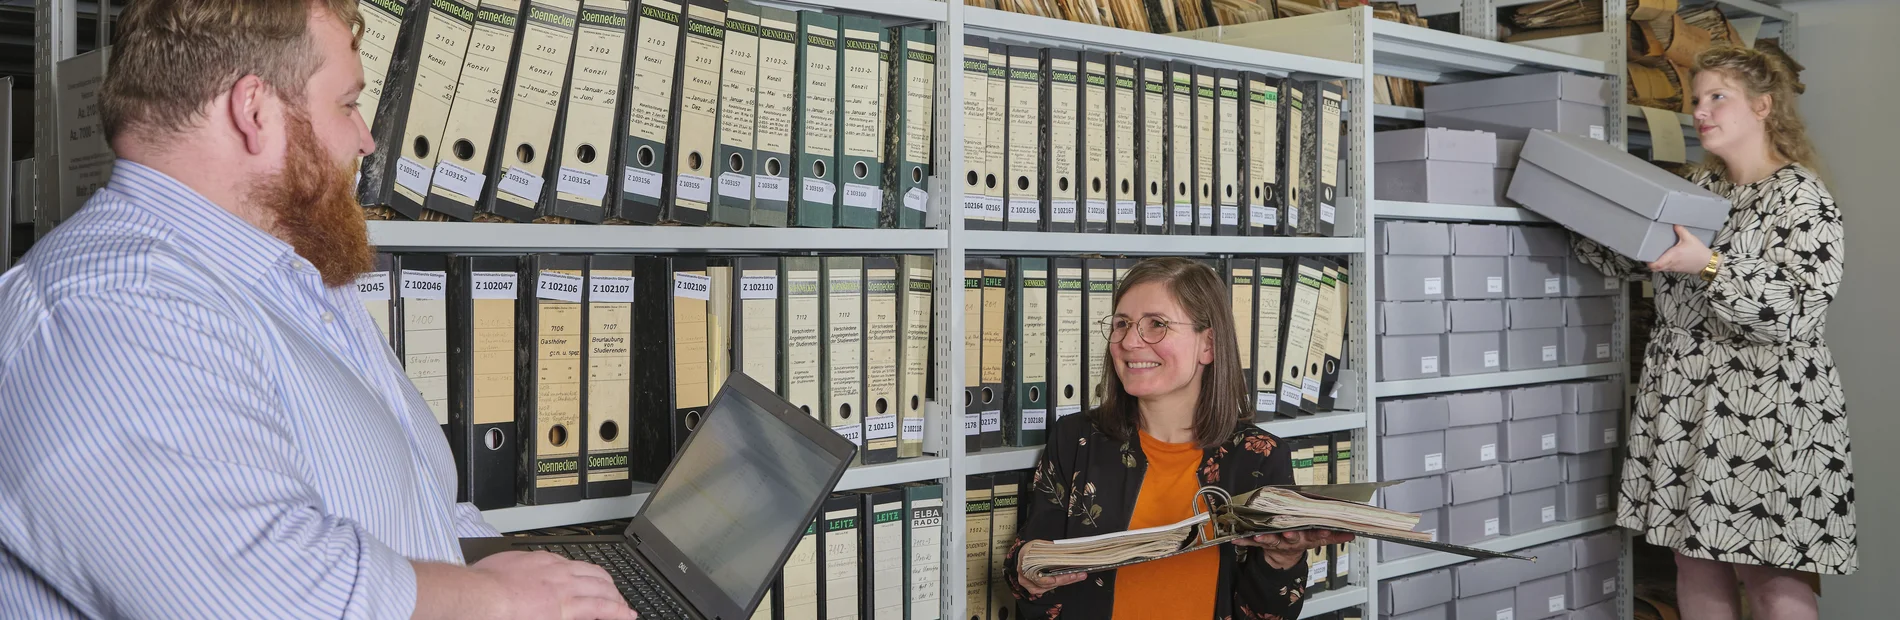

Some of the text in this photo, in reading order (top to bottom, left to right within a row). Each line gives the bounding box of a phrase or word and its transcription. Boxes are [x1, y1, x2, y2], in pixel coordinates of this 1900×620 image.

[432, 0, 475, 22] Soennecken
[642, 6, 679, 24] SOENNECKEN
[477, 8, 516, 27] oennecken
[529, 7, 575, 28] Soennecken
[582, 10, 626, 27] Soennecken
[688, 20, 724, 38] Soennecken
[726, 20, 758, 35] SOENNECKEN
[366, 28, 386, 41] 2103
[762, 28, 794, 40] SOENNECKEN
[436, 34, 454, 46] 2103
[648, 38, 666, 46] 2103
[808, 35, 836, 47] SOENNECKEN
[846, 40, 878, 50] SOENNECKEN
[476, 42, 496, 52] 2103
[536, 44, 556, 54] 2103
[589, 46, 610, 54] 2103
[428, 54, 446, 66] Konzil
[644, 56, 662, 64] Konzil
[696, 56, 712, 64] 2103
[908, 51, 934, 62] SOENNECKEN
[466, 62, 490, 72] Konzil
[528, 65, 553, 76] Konzil
[584, 66, 608, 76] Konzil
[730, 68, 746, 76] Konzil
[1011, 69, 1037, 79] Soennecken
[1052, 71, 1076, 82] Soennecken
[692, 76, 712, 86] Konzil
[526, 84, 548, 94] Januar
[582, 85, 603, 93] Januar
[691, 95, 708, 103] Januar
[1324, 99, 1338, 109] ELBA
[404, 165, 420, 178] 103151
[440, 166, 468, 183] Z 103152
[508, 172, 530, 186] 103153
[568, 175, 591, 185] 103154
[632, 176, 650, 184] 103156
[724, 179, 740, 187] 103157
[683, 181, 700, 189] 103155
[405, 280, 442, 290] Z 102046
[483, 282, 513, 290] 102047
[541, 281, 578, 293] Z 102106
[677, 281, 707, 292] Z 102109
[749, 283, 774, 291] 102110
[868, 282, 895, 291] Soennecken
[984, 278, 1001, 286] EHLE
[1058, 280, 1081, 288] Soennecken
[1090, 282, 1113, 290] Soennecken
[357, 283, 384, 293] 2045
[600, 285, 629, 293] 102107
[873, 422, 894, 431] 102113
[842, 432, 859, 440] 2112
[589, 454, 628, 468] Soennecken
[538, 460, 578, 473] Soennecken
[994, 496, 1018, 506] Soennecken
[876, 511, 898, 522] LEITZ
[914, 509, 939, 518] ELBA
[830, 519, 854, 530] LEITZ
[914, 518, 939, 526] RADO
[678, 562, 688, 573] DELL
